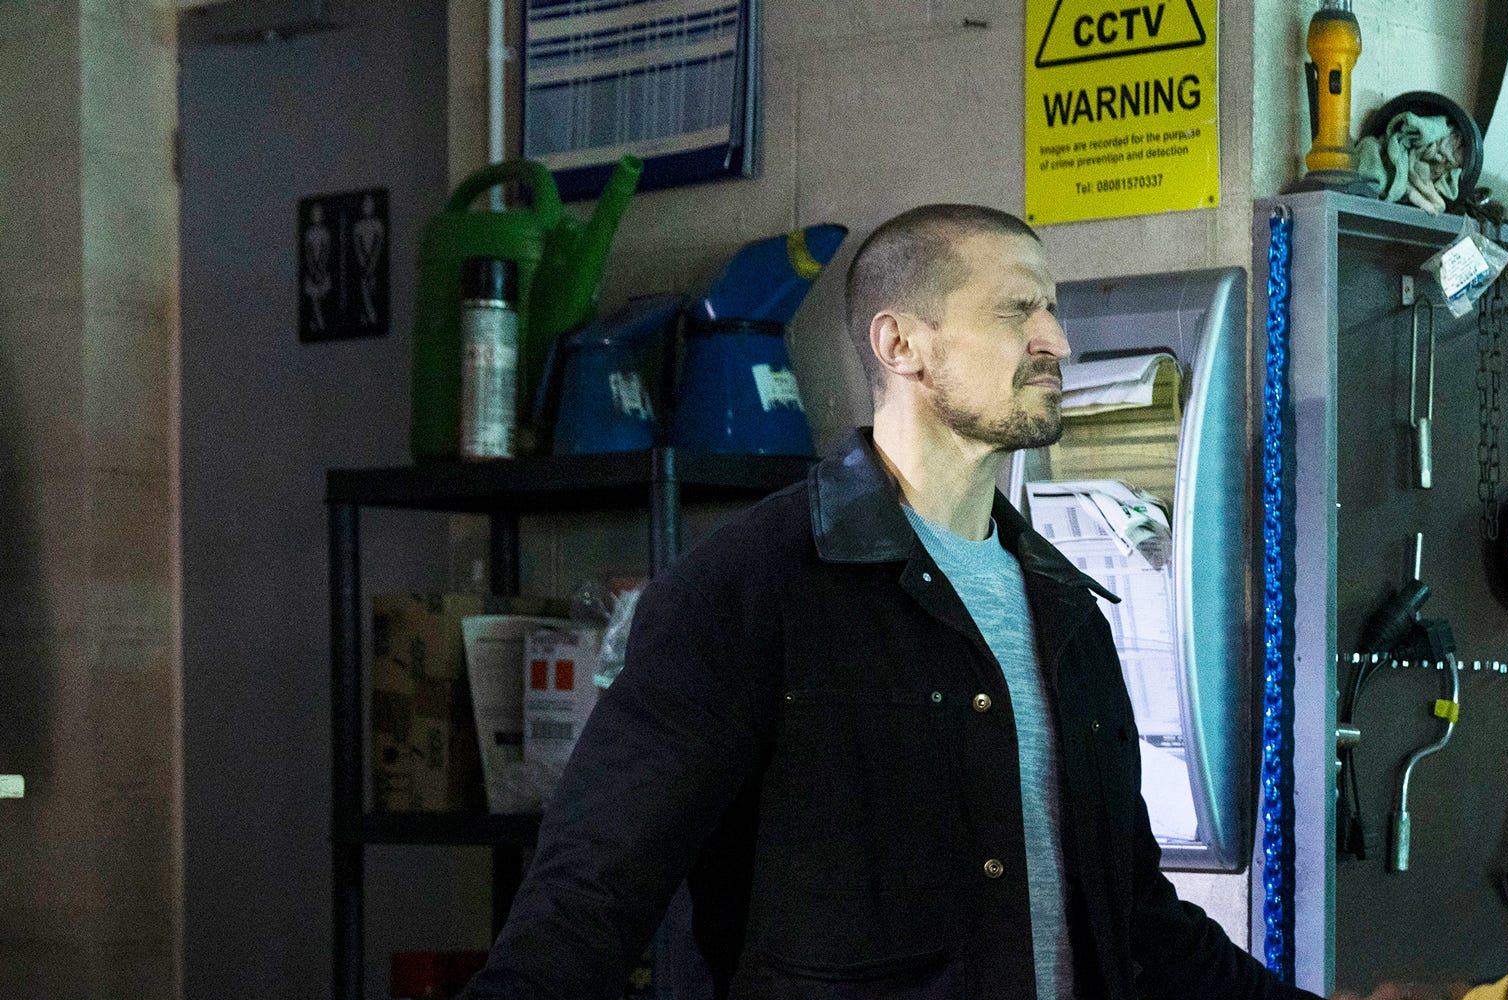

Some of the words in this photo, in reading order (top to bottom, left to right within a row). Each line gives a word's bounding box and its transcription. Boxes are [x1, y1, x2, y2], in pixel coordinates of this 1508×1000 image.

[1073, 3, 1165, 47] CCTV
[1043, 74, 1201, 127] WARNING
[1073, 141, 1086, 152] are
[1089, 136, 1129, 149] recorded
[1131, 134, 1143, 145] for
[1146, 132, 1161, 142] the
[1163, 128, 1201, 143] purpse
[1039, 160, 1049, 171] of
[1051, 158, 1075, 169] crime
[1076, 152, 1124, 168] prevention
[1126, 150, 1144, 161] and
[1146, 145, 1189, 159] detection
